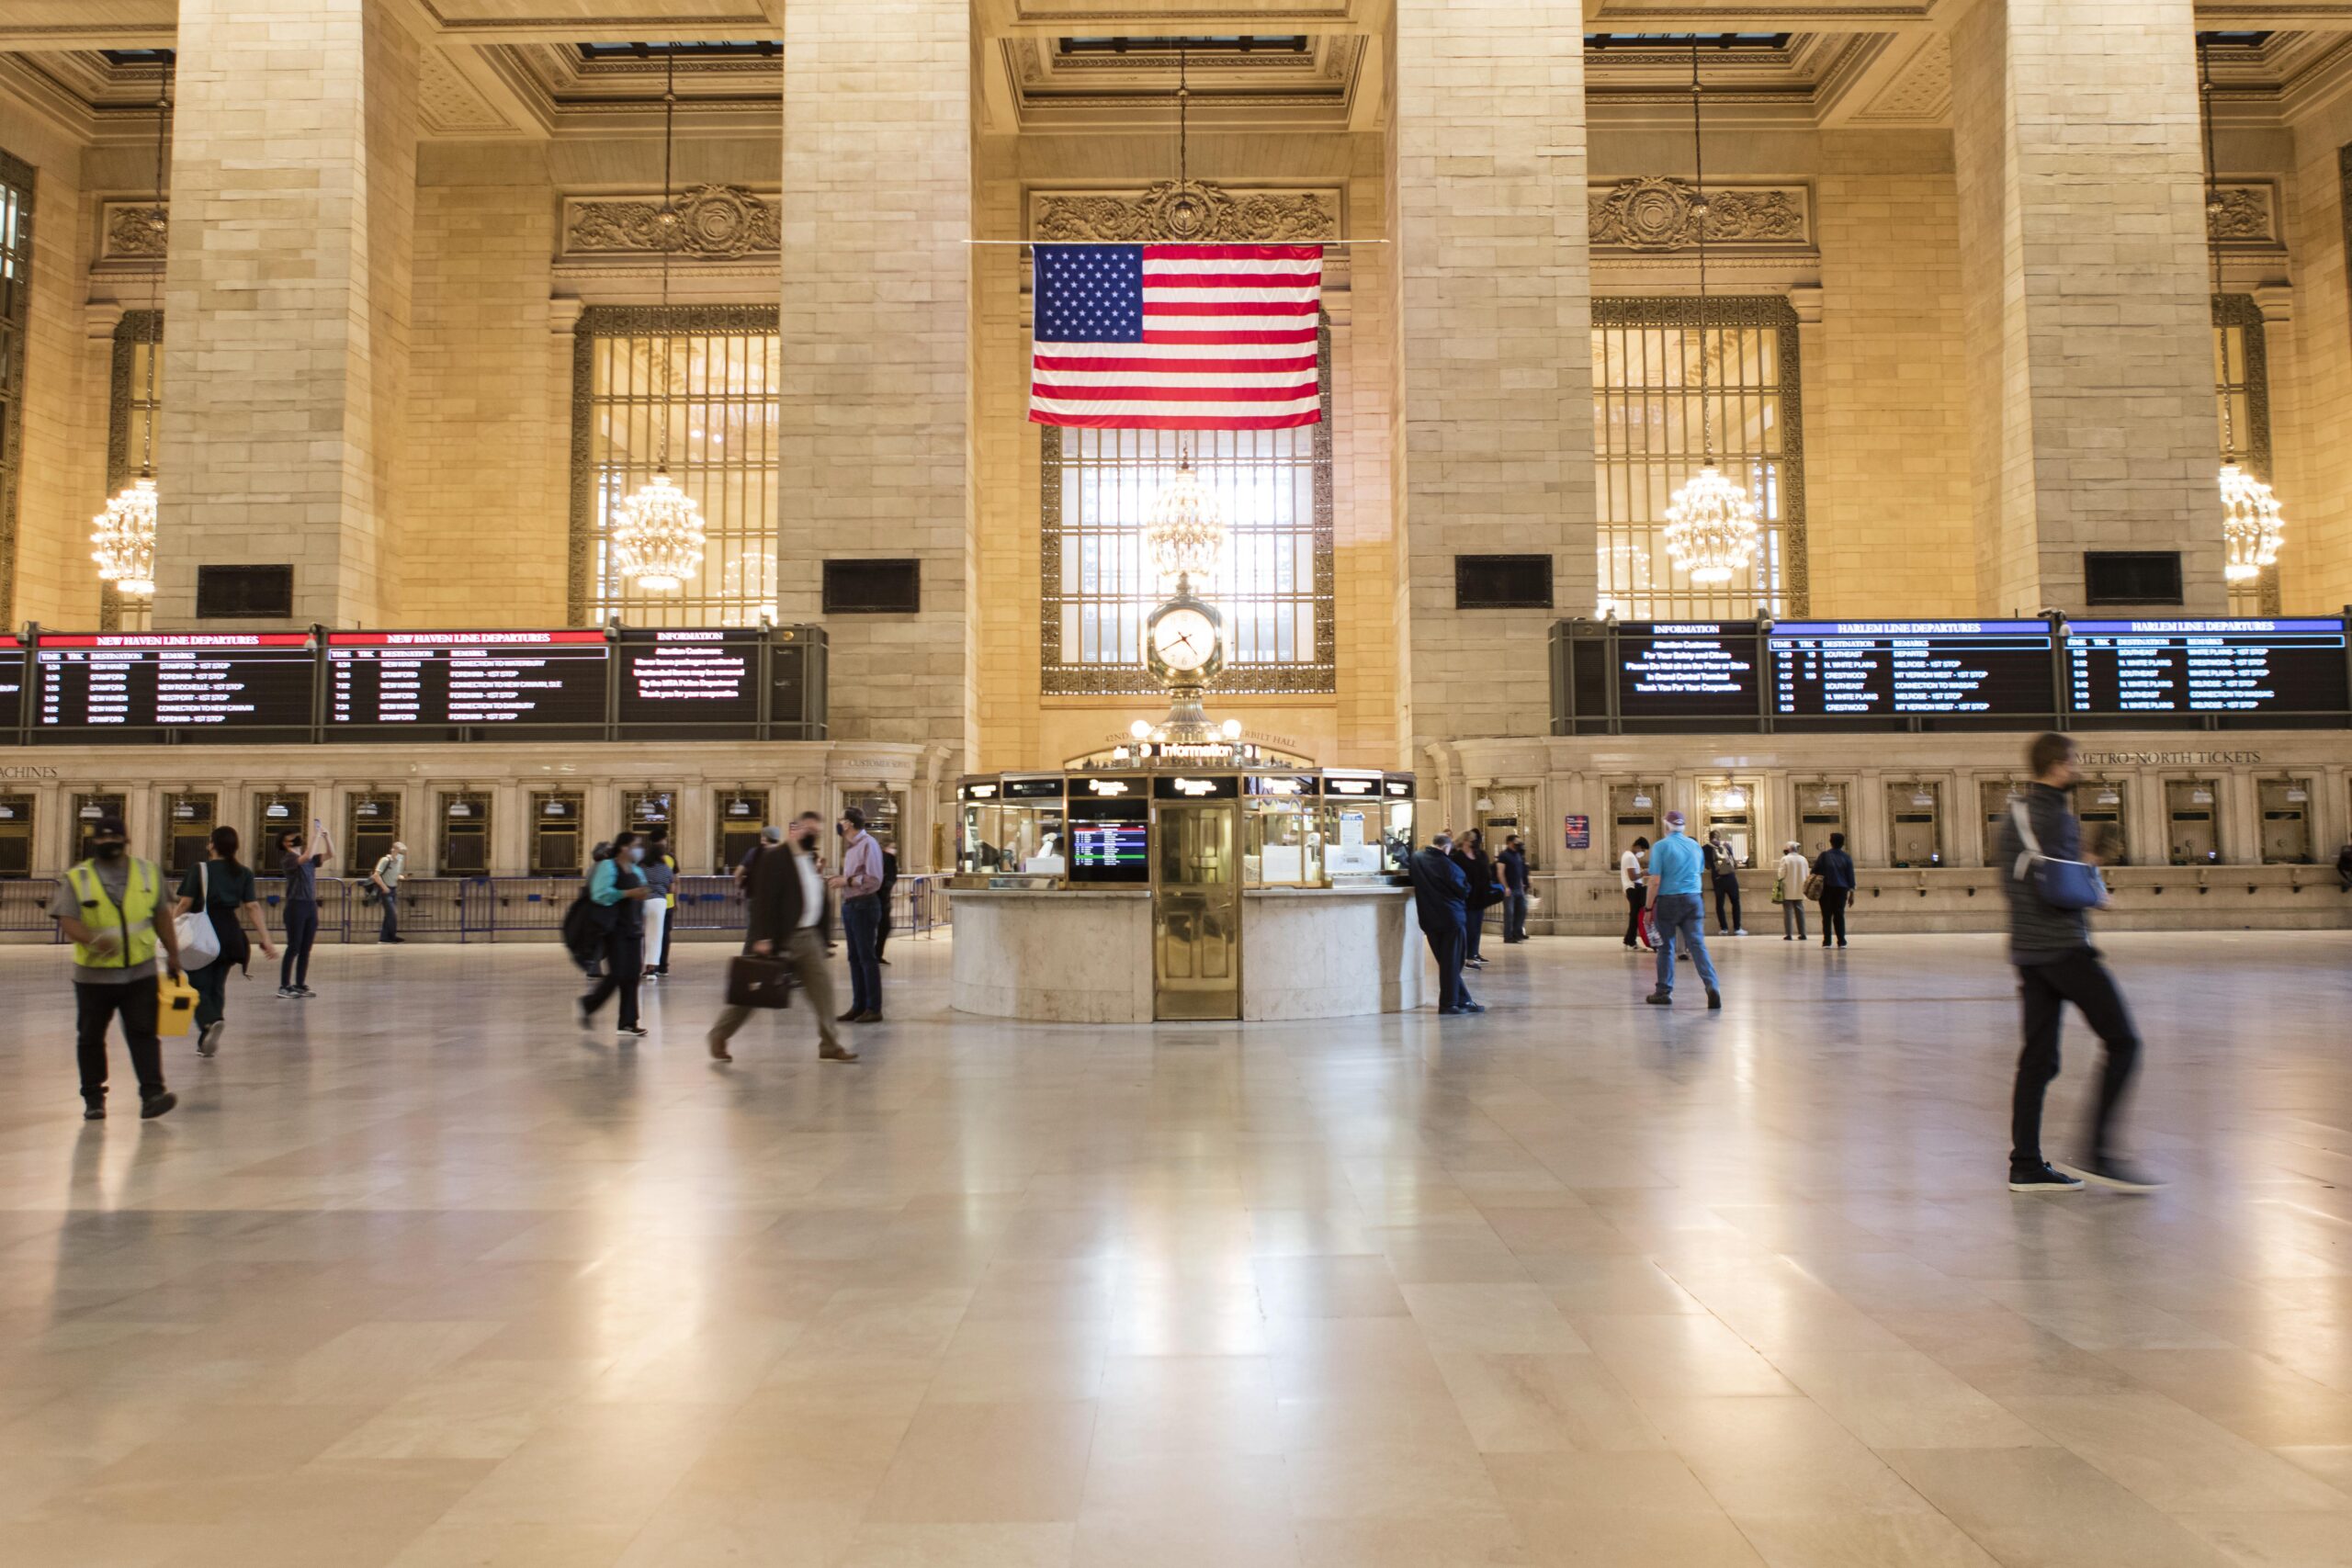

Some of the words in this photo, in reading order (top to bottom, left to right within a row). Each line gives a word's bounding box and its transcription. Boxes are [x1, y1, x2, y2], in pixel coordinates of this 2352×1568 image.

[1838, 625, 1883, 633] HARLEM
[1884, 625, 1910, 633] LINE
[1912, 624, 1981, 633] DEPARTURES
[2132, 623, 2177, 631] HARLEM
[2179, 622, 2204, 631] LINE
[2206, 622, 2275, 631] DEPARTURES
[97, 637, 122, 645] NEW
[124, 637, 162, 645] HAVEN
[164, 636, 189, 645] LINE
[191, 636, 259, 645] DEPARTURES
[388, 635, 413, 643] NEW
[414, 635, 453, 643] HAVEN
[455, 634, 480, 642] LINE
[481, 634, 550, 642] DEPARTURES
[1272, 736, 1296, 747] HALL
[1161, 743, 1232, 757] Information
[2075, 752, 2191, 764] METRO-NORTH
[2198, 750, 2261, 763] TICKETS
